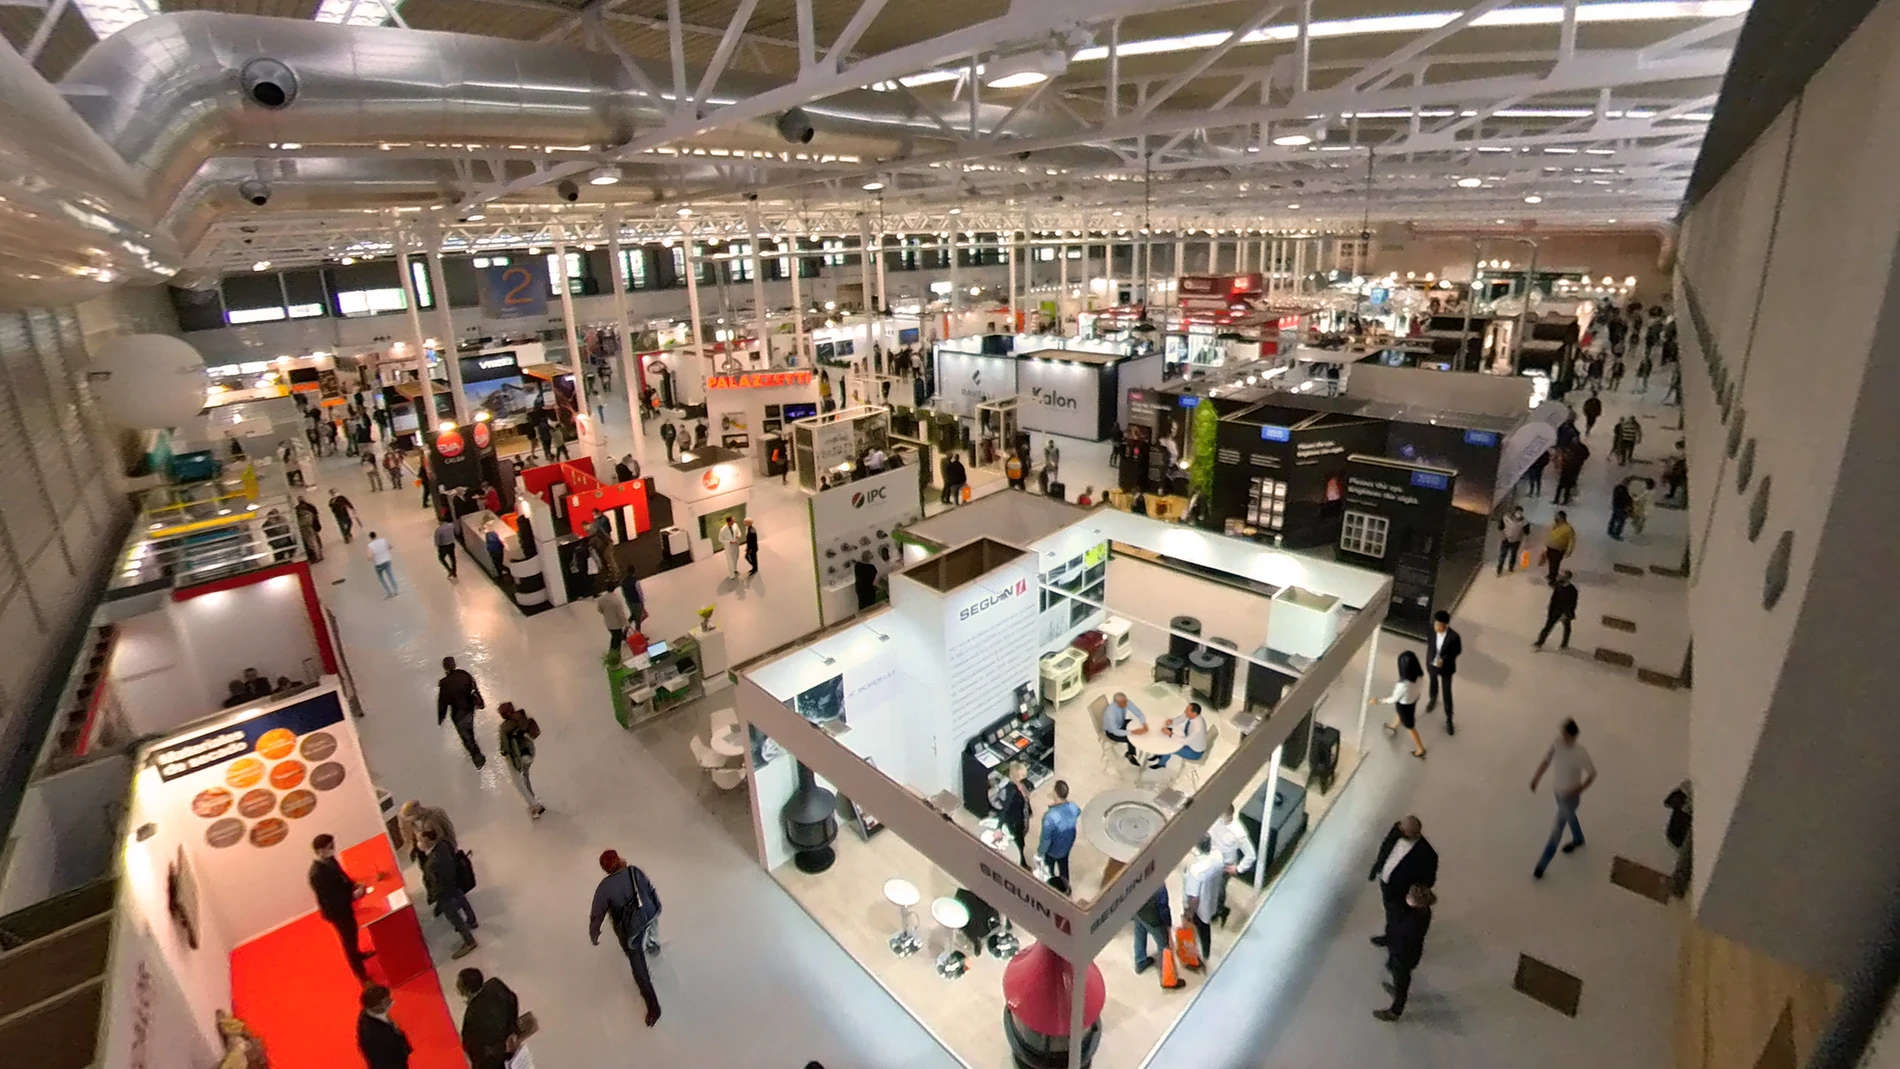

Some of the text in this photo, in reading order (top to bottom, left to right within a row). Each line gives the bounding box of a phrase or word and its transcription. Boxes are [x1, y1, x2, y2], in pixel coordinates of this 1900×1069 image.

[503, 267, 535, 305] 2
[867, 486, 887, 503] IPC
[959, 585, 1014, 622] SEGUN
[980, 862, 1051, 918] SEGUIN
[1090, 877, 1143, 935] SEGUIN
